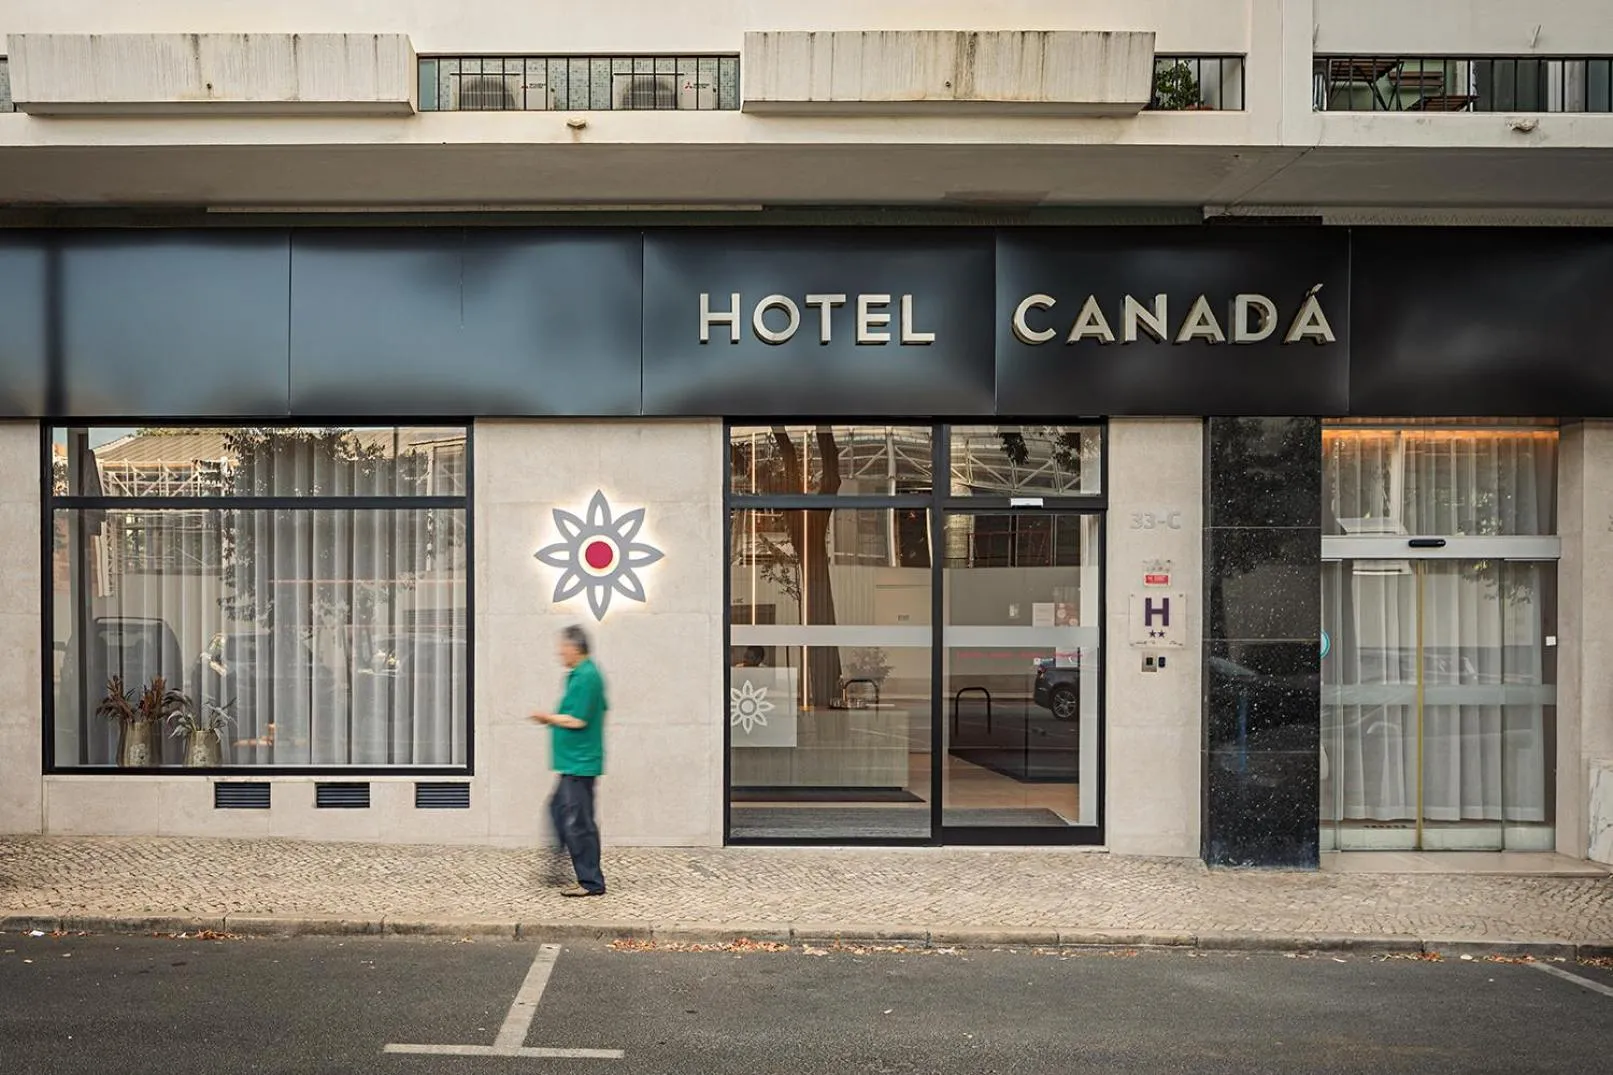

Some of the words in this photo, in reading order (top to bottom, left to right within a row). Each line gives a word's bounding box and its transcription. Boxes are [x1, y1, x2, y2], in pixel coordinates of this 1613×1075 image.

[699, 292, 936, 345] HOTEL
[1011, 282, 1337, 345] CANADÁ
[1129, 511, 1182, 530] 33-C
[1144, 597, 1170, 627] H
